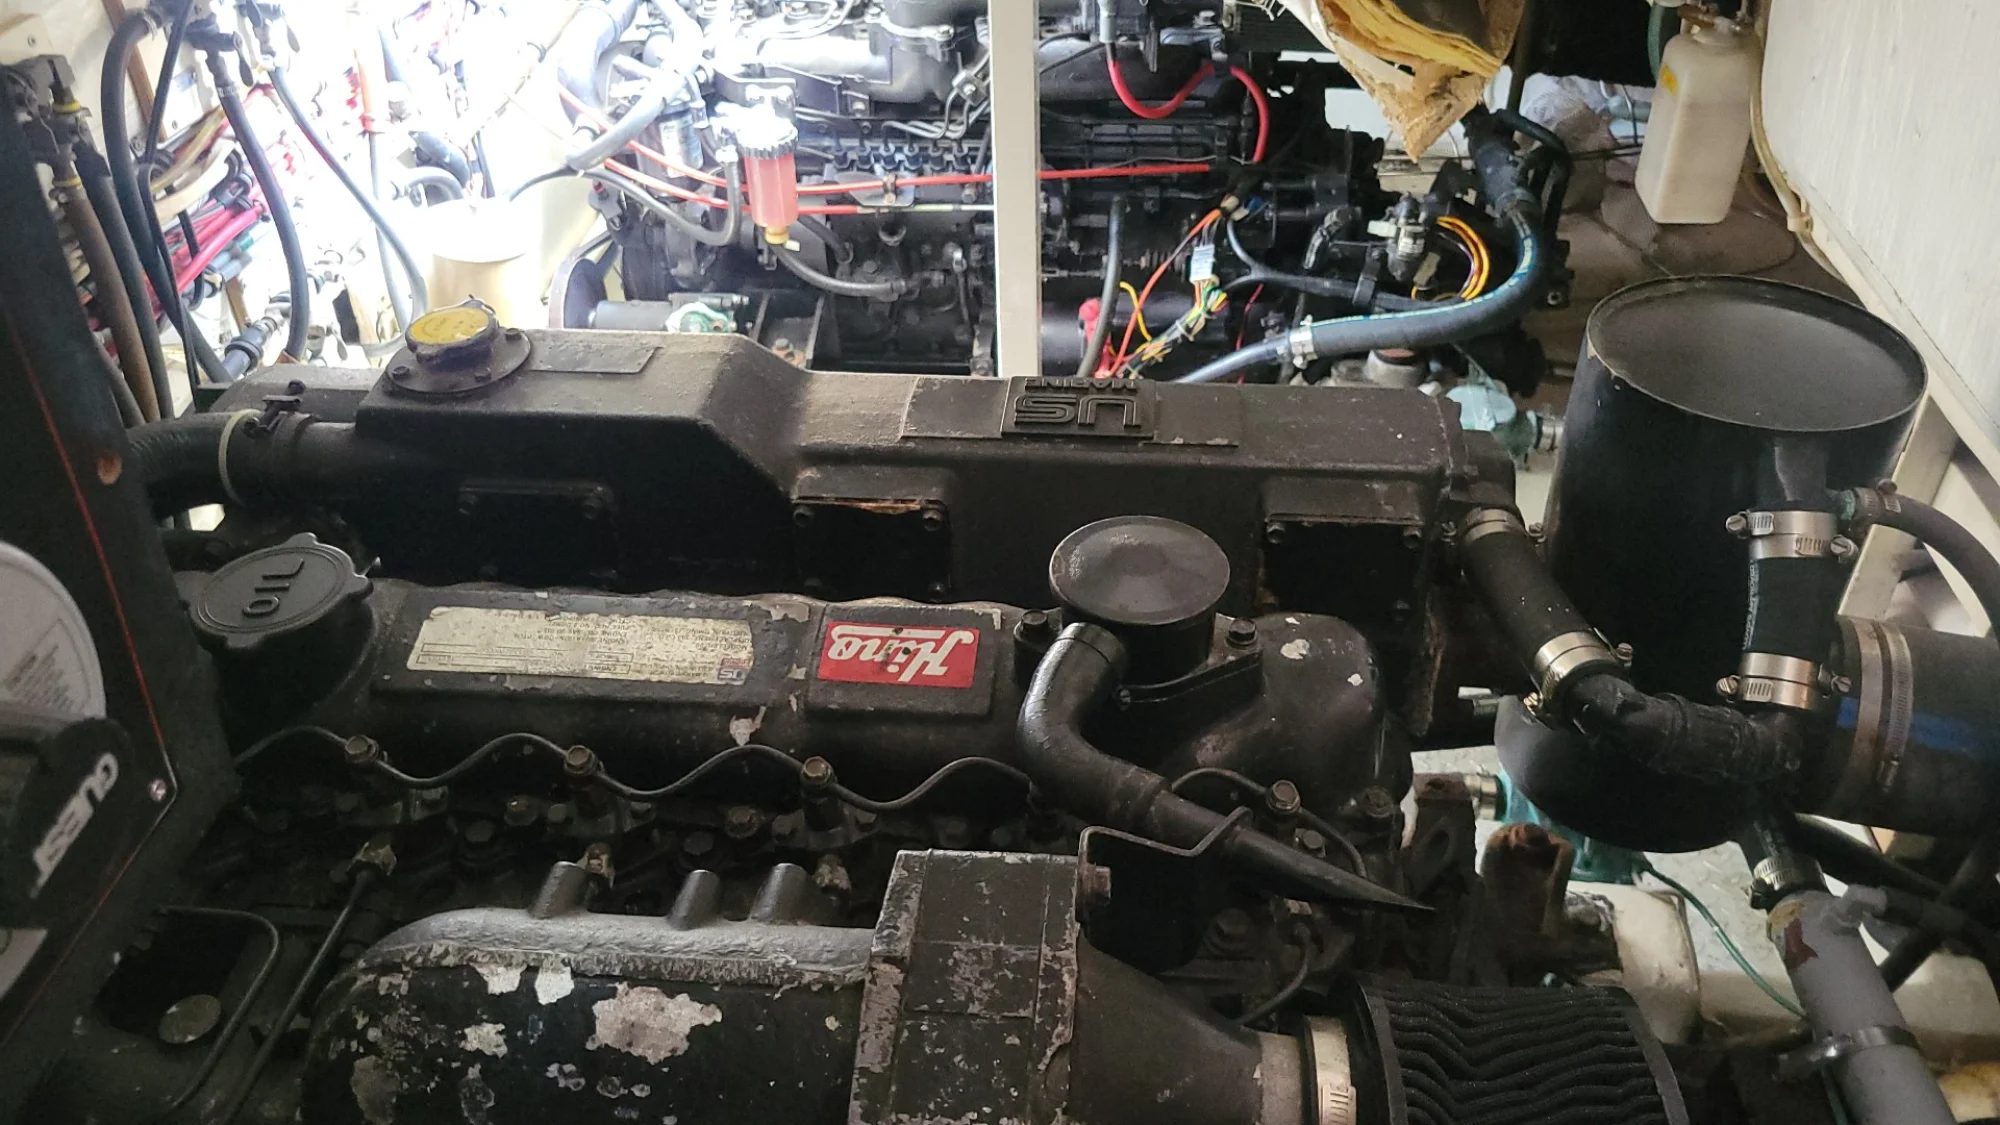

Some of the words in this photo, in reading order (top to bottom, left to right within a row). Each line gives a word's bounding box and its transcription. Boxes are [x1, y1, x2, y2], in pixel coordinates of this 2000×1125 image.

[1014, 393, 1141, 428] US
[242, 558, 305, 617] OIL
[828, 625, 974, 683] Hino
